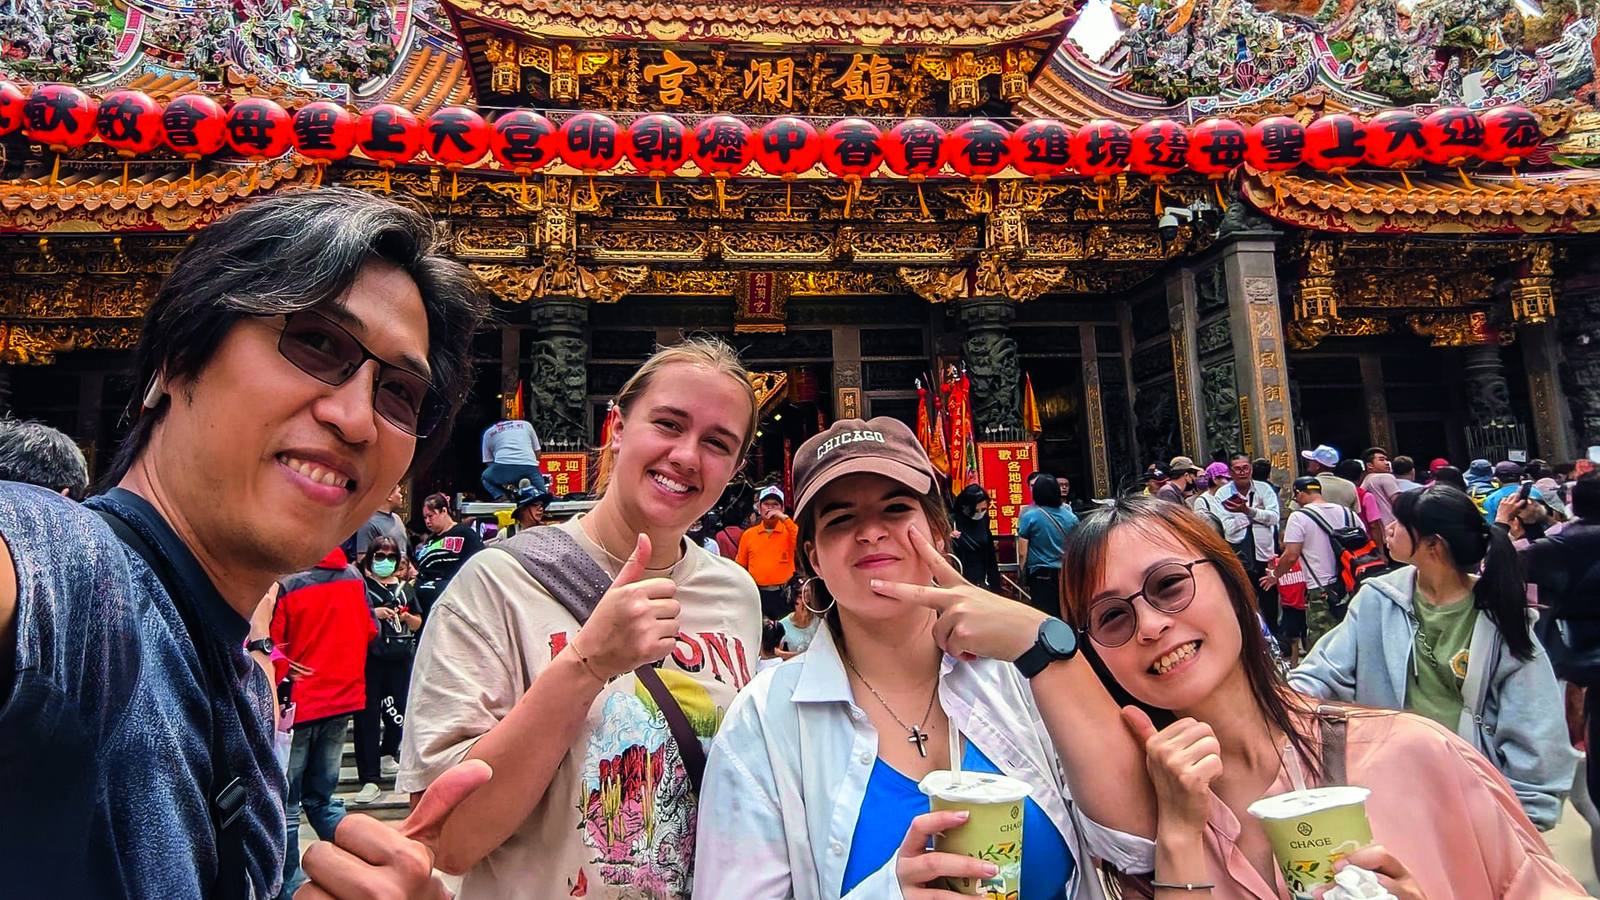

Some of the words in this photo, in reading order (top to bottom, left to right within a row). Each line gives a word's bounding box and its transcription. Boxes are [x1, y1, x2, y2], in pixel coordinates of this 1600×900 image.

[643, 50, 894, 109] 鎮瀾宮
[1260, 351, 1290, 471] 風調雨順
[817, 430, 886, 460] CHICAGO
[998, 450, 1029, 460] 歡迎
[547, 460, 579, 472] 歡迎
[1290, 838, 1332, 849] CHAGE
